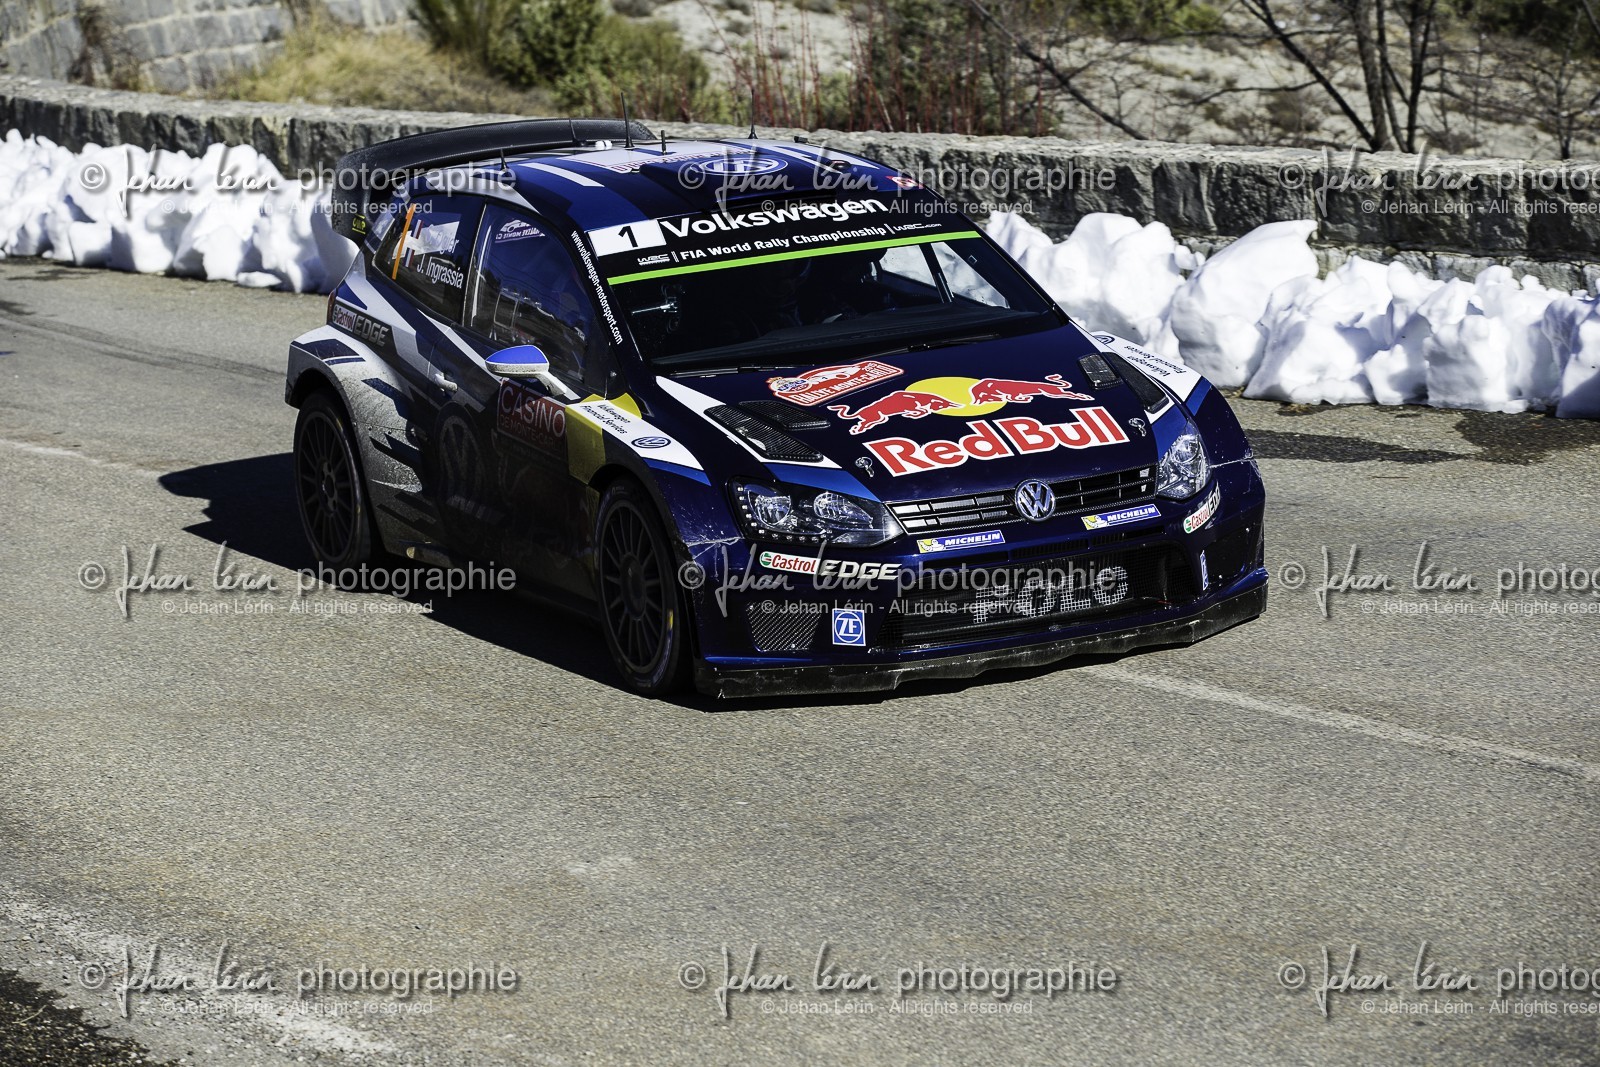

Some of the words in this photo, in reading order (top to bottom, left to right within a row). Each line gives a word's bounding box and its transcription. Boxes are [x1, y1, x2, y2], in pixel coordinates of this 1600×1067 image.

[660, 198, 889, 238] Volkswagen
[618, 226, 638, 248] 1
[681, 247, 707, 261] FIA
[707, 242, 751, 256] World
[754, 237, 790, 250] Rally
[793, 225, 886, 245] Championship
[425, 256, 464, 289] Ingrassia
[571, 230, 623, 345] www.volkswagen-motorsport.com
[354, 315, 389, 347] EDGE
[501, 386, 566, 437] CASINO
[597, 403, 631, 424] Volkswagen
[863, 420, 1014, 476] Red
[993, 406, 1130, 454] Bull
[1107, 506, 1156, 522] MICHELIN
[945, 532, 1001, 546] MICHELIN
[771, 554, 817, 573] Castrol
[820, 559, 902, 581] EDGE
[973, 566, 1129, 624] POLO
[836, 617, 861, 637] ZF
